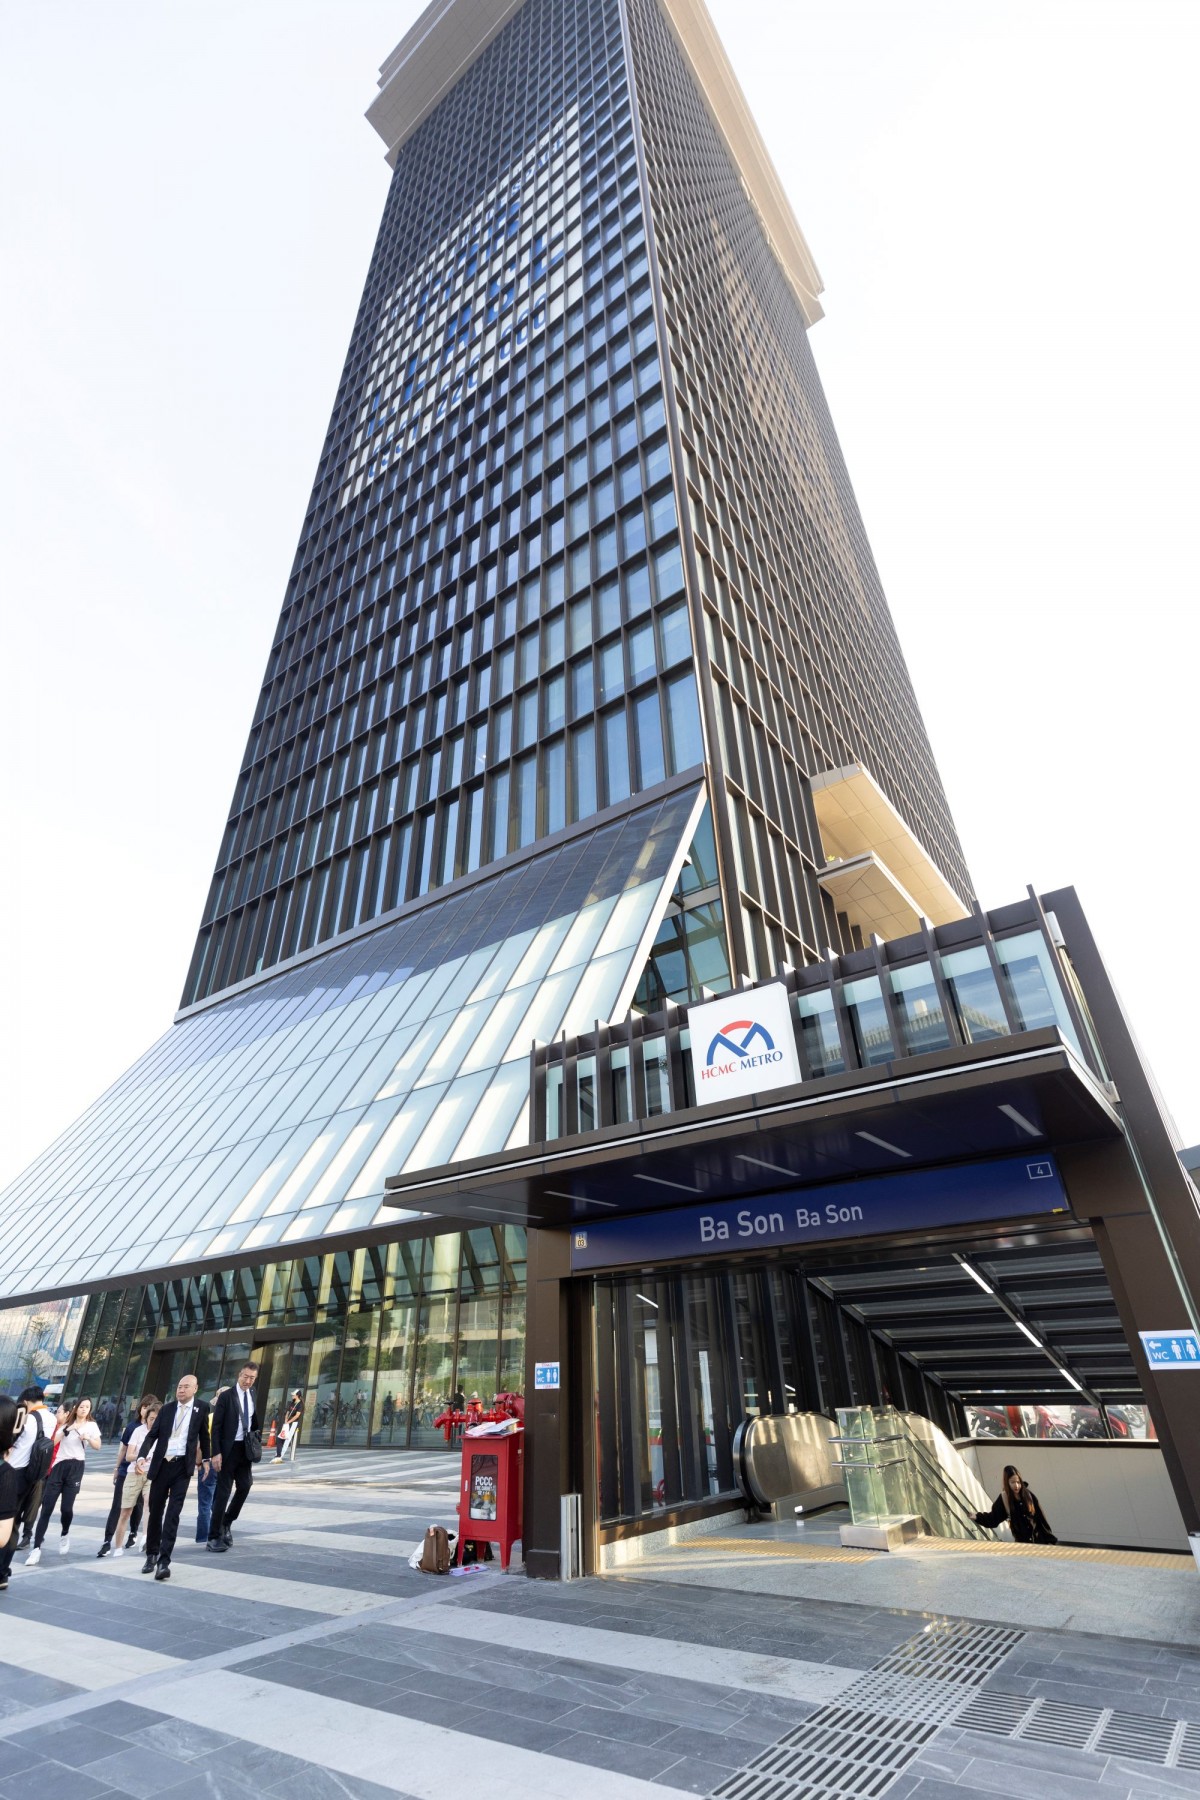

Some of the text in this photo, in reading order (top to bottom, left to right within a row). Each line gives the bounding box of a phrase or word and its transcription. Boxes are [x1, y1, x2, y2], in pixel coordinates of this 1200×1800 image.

[415, 193, 522, 330] FOR
[366, 214, 563, 438] LEASE
[701, 1050, 783, 1080] HCMC METRO
[1037, 1166, 1043, 1175] 4
[699, 1204, 864, 1242] Ba Son Ba Son
[1152, 1351, 1170, 1360] WC
[475, 1476, 493, 1486] PCCC
